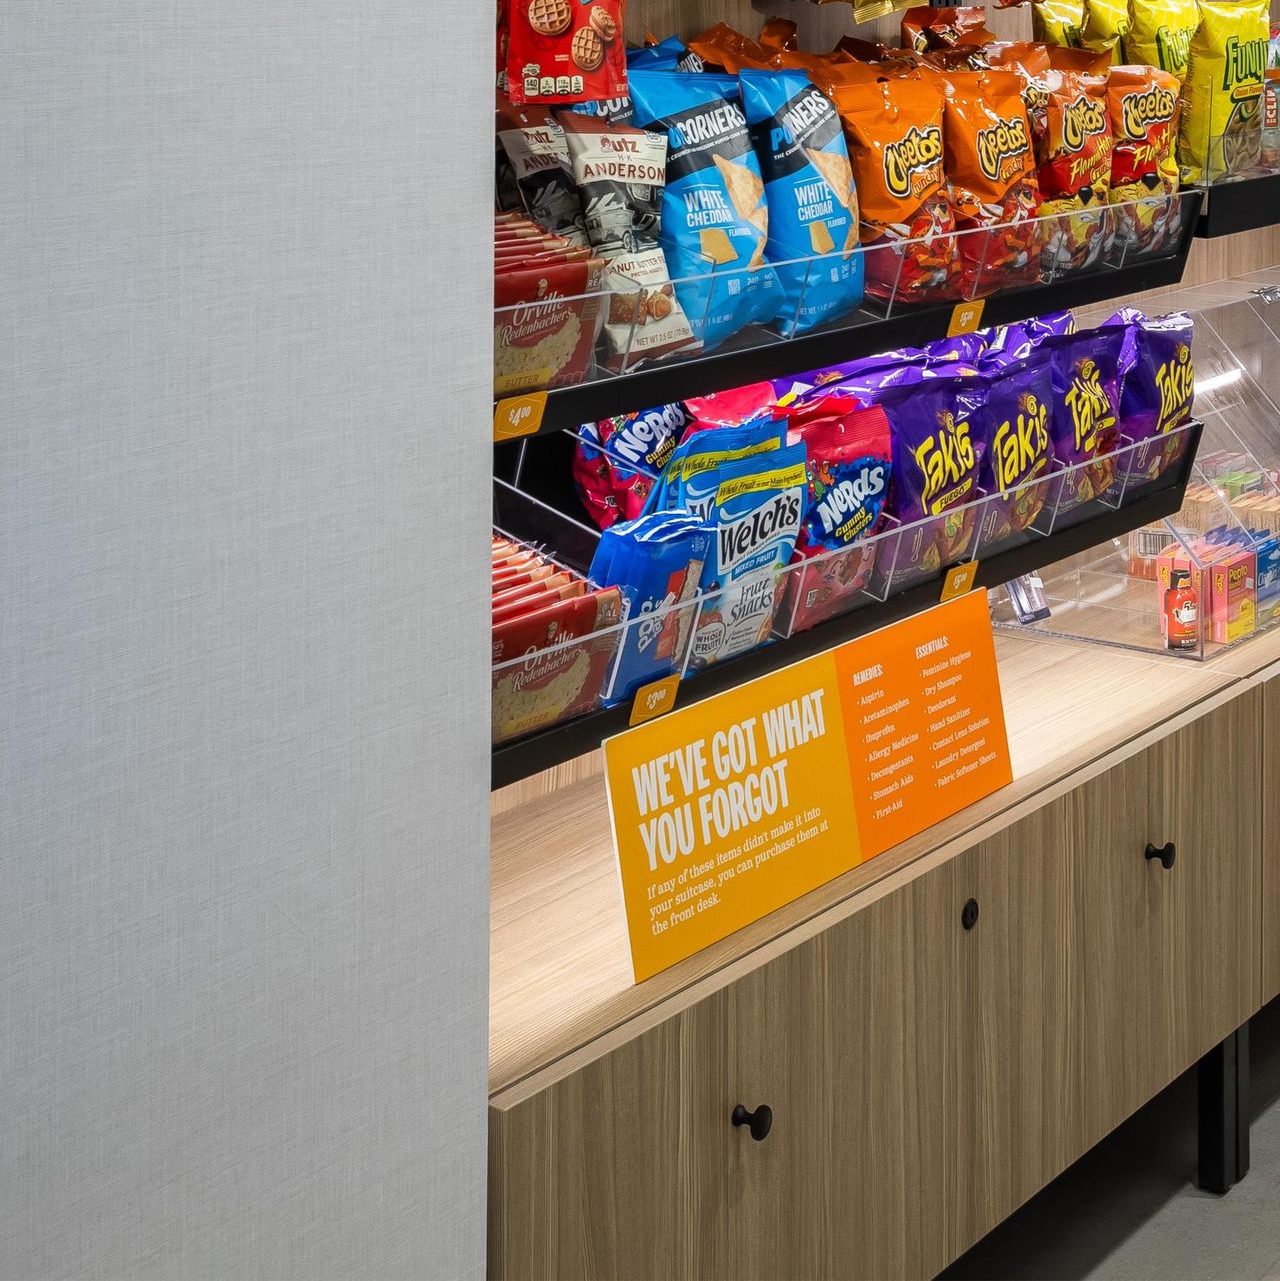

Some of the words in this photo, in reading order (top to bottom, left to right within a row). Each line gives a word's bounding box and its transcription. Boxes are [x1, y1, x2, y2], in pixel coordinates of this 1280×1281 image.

[525, 77, 538, 87] 140
[1266, 88, 1277, 118] CLIF
[583, 162, 665, 180] ANDERSON
[683, 187, 728, 213] WHITE
[794, 181, 831, 208] WHITE
[686, 205, 734, 228] CHEDDAR
[797, 199, 833, 222] CHEDDAR
[513, 294, 565, 327] Orville
[500, 309, 573, 347] Redenbacher's
[636, 338, 649, 348] NET
[649, 337, 658, 346] WT
[658, 335, 668, 344] 2.5
[667, 334, 674, 343] OZ
[504, 373, 540, 388] BUTTER
[1155, 359, 1194, 431] Takis
[993, 403, 1048, 501] Takis
[915, 421, 974, 515] Takis
[719, 483, 738, 497] Whole
[738, 479, 756, 492] Fruit
[939, 483, 967, 508] FUEGO
[720, 495, 801, 566] Welch's
[835, 506, 866, 537] Gummy
[843, 512, 873, 542] Clusters
[735, 559, 755, 576] MIXED
[756, 551, 776, 568] FRUIT
[1228, 564, 1248, 583] Pepto
[739, 577, 771, 606] Fruit
[730, 590, 773, 625] Snacks
[524, 630, 574, 672] Orville
[696, 631, 721, 644] WHOLE
[915, 635, 949, 659] ESSENTIALS:
[512, 645, 582, 692] Redenbacher's
[852, 664, 884, 686] REMEDIES:
[922, 660, 949, 678] Feminine
[949, 650, 972, 666] Hygiene
[860, 689, 885, 706] Aspirin
[925, 684, 936, 696] Dry
[937, 674, 963, 691] Shampoo
[863, 698, 910, 725] Acetaminophen
[927, 695, 957, 714] Deodorant
[865, 723, 896, 744] Ibuprofen
[930, 720, 946, 733] Hand
[946, 707, 971, 726] Sanitizer
[868, 745, 891, 762] Allergy
[892, 733, 919, 752] Medicine
[932, 735, 954, 751] Contact
[954, 727, 968, 740] Lens
[968, 717, 990, 733] Solution
[632, 738, 711, 816] WE'VE
[711, 717, 757, 781] GOT
[762, 688, 826, 758] WHAT
[935, 752, 959, 769] Laundry
[960, 738, 986, 756] Detergent
[870, 755, 914, 781] Decongestants
[937, 773, 955, 788] Fabric
[956, 761, 979, 778] Softener
[979, 751, 997, 767] Sheets
[873, 782, 900, 801] Stomach
[900, 774, 914, 787] Aids
[639, 802, 695, 871] YOU
[698, 759, 789, 845] FORGOT
[876, 800, 903, 819] First-Aid
[648, 884, 658, 900] If
[658, 878, 676, 895] any
[678, 873, 690, 885] of
[689, 861, 714, 880] these
[716, 848, 742, 865] items
[744, 831, 768, 851] didn't
[771, 820, 794, 839] make
[795, 814, 803, 827] it
[804, 808, 821, 822] into
[649, 901, 672, 921] your
[675, 880, 717, 905] suitcase,
[718, 869, 736, 886] you
[736, 860, 753, 874] can
[755, 839, 795, 868] purchase
[797, 828, 818, 844] them
[820, 820, 829, 832] at
[652, 921, 668, 936] the
[670, 907, 695, 926] front
[697, 893, 721, 911] desk.
